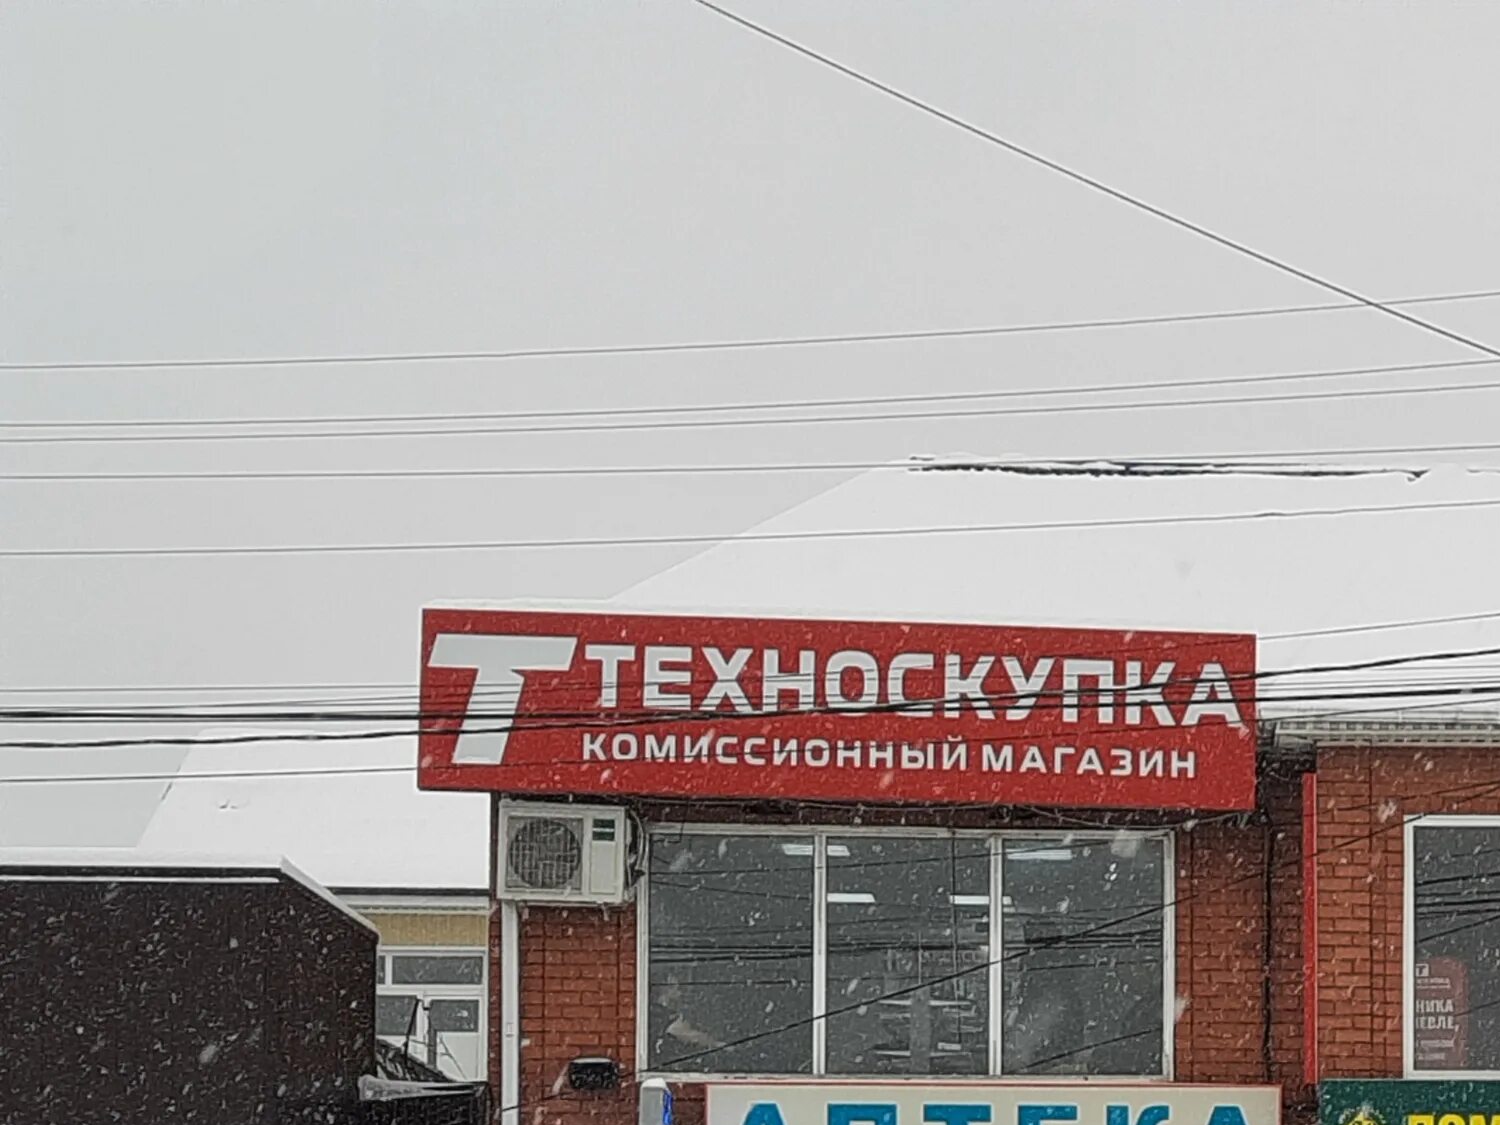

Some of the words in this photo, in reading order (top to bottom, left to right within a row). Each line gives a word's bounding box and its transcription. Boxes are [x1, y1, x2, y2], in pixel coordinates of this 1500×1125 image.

[582, 643, 1246, 731] ТЕХНОСКУПКА
[581, 731, 968, 771] КОМИССИОННЫЙ
[979, 742, 1197, 779] МАГАЗИН
